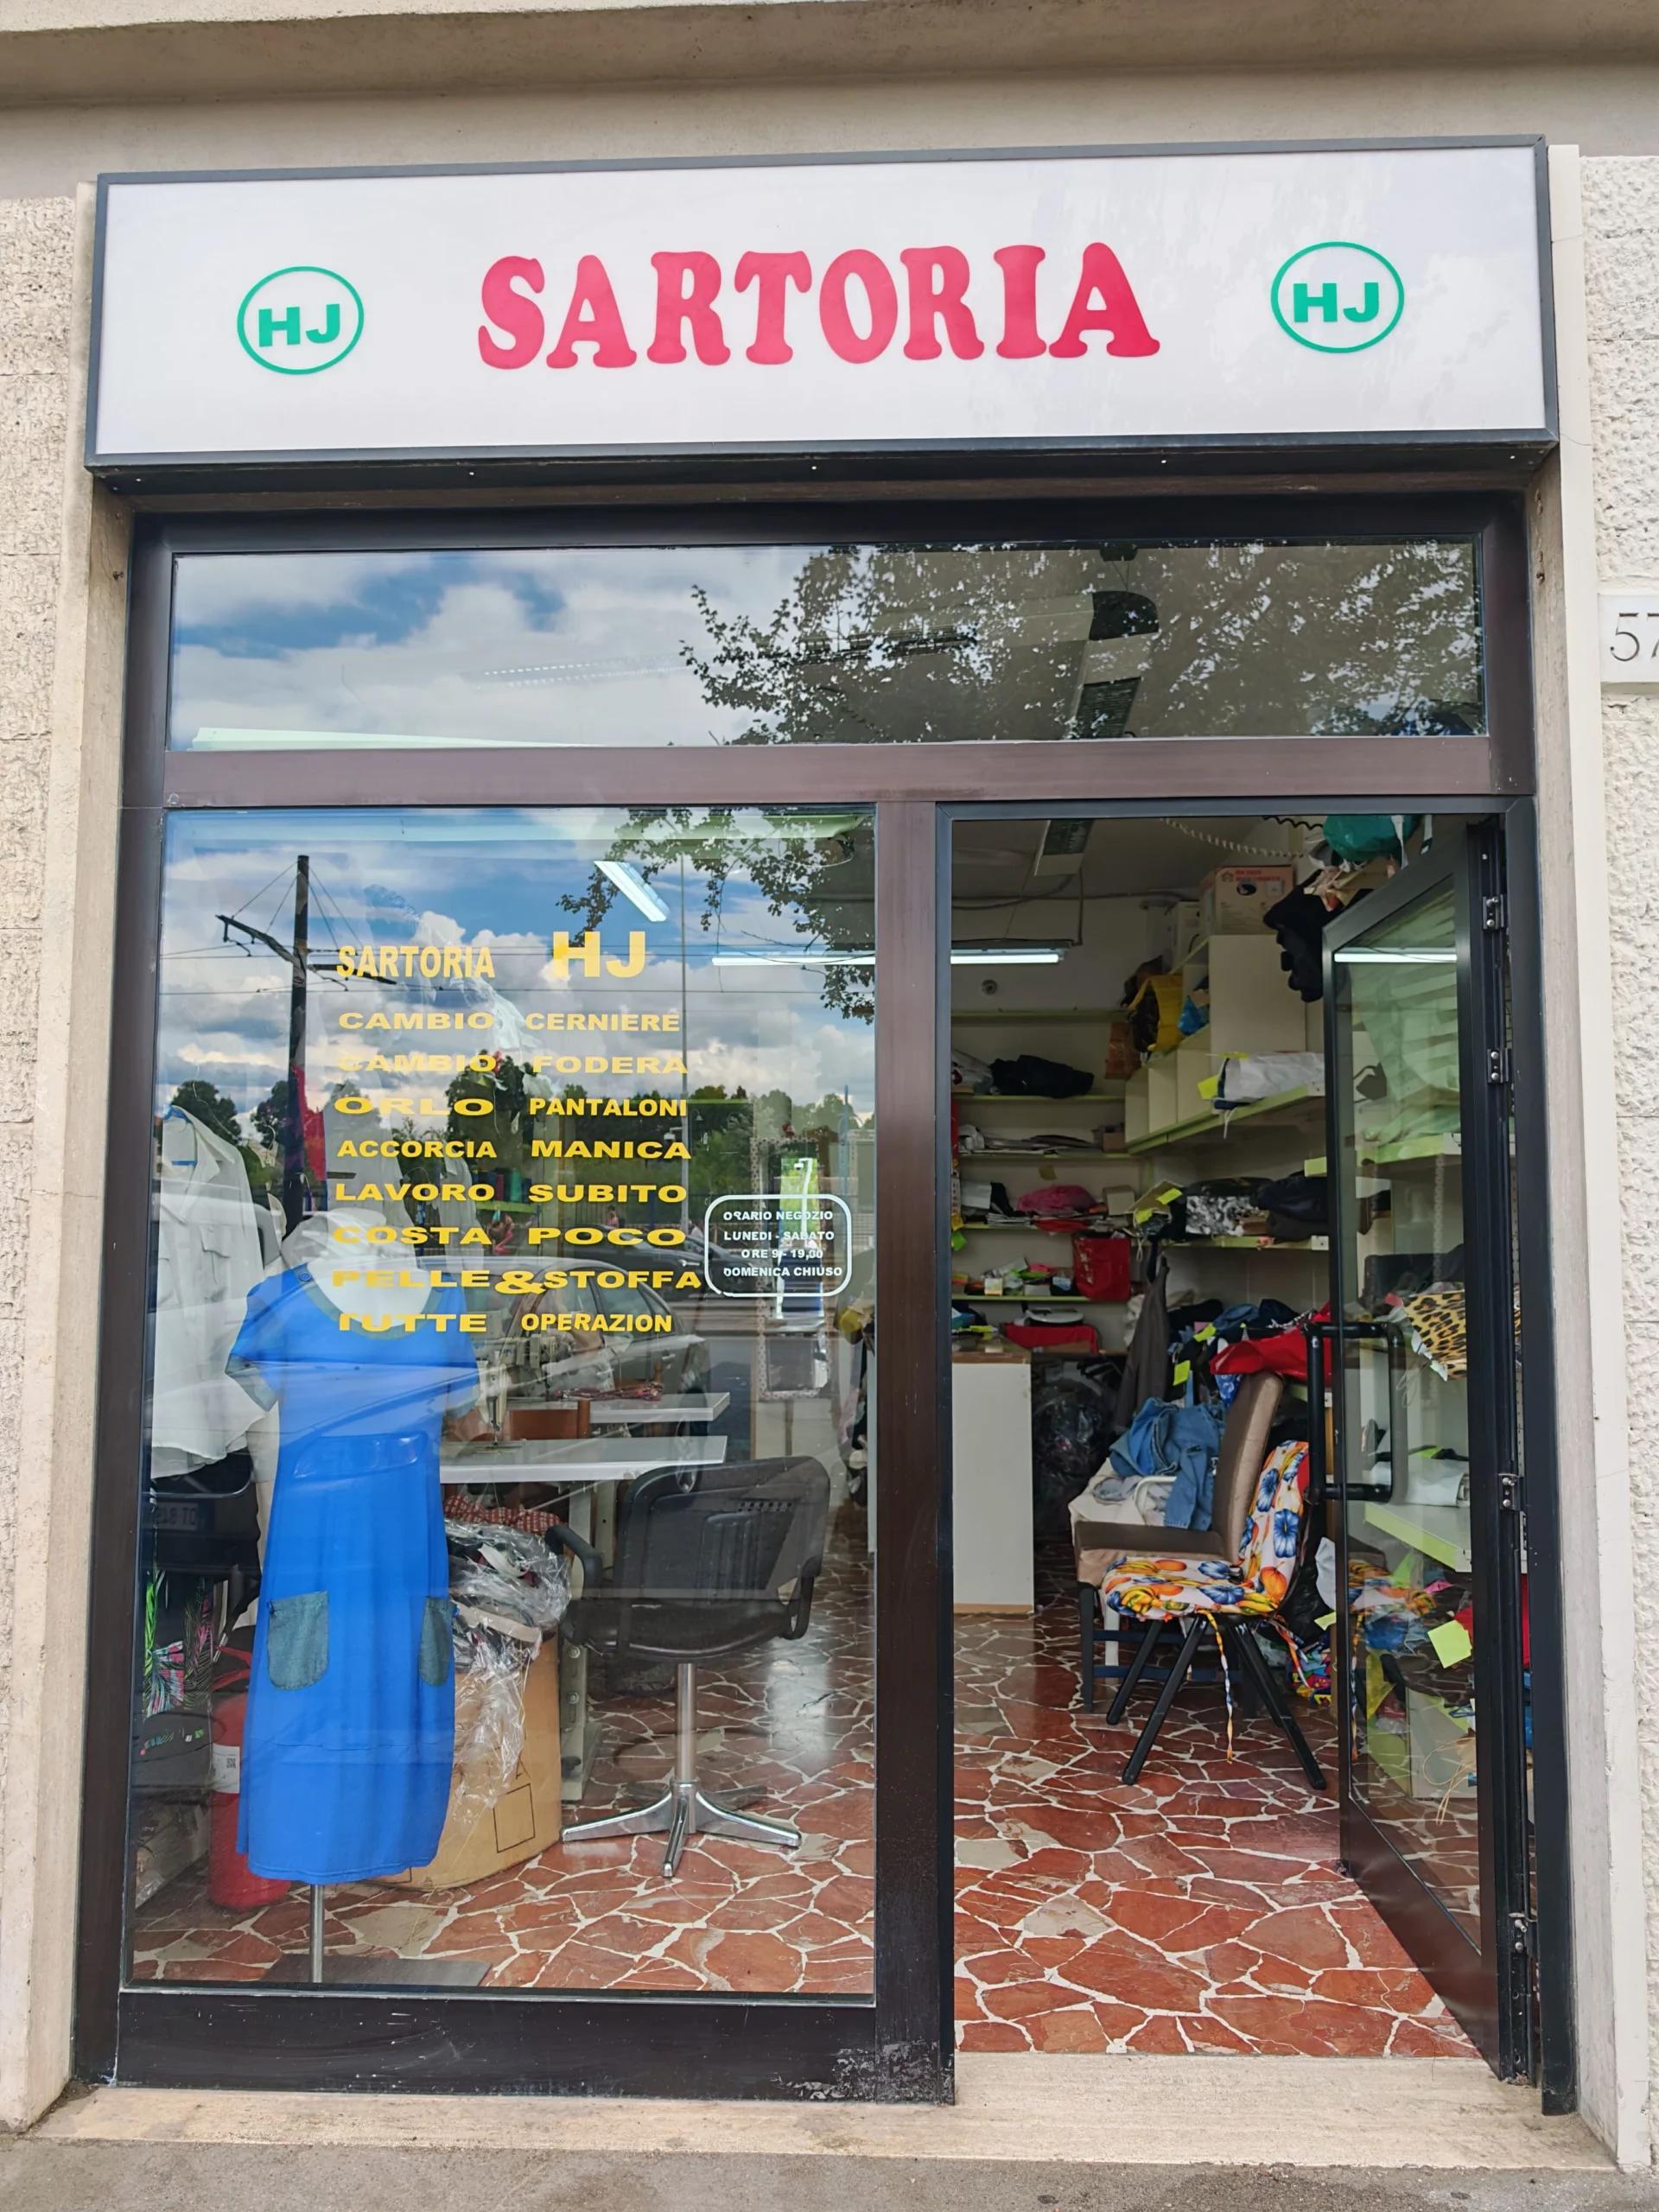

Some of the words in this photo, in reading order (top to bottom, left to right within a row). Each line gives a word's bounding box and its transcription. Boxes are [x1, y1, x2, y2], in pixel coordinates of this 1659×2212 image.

[478, 242, 1160, 370] SARTORIA
[1293, 281, 1381, 323] HJ
[258, 303, 341, 347] HJ
[336, 945, 495, 978] SARTORIA
[552, 931, 646, 978] HJ
[338, 1012, 493, 1030] CAMBIO
[525, 1013, 680, 1032] CERNIERE
[336, 1054, 497, 1072] CAMBIO
[532, 1056, 688, 1074] FODERA
[334, 1096, 494, 1116] ORLO
[530, 1097, 687, 1116] PANTALONI
[337, 1140, 498, 1159] ACCORCIA
[531, 1140, 691, 1160] MANICA
[335, 1183, 495, 1202] LAVORO
[529, 1184, 687, 1203] SUBITO
[723, 1211, 772, 1221] ORARIO
[776, 1211, 834, 1221] NEGOZIO
[333, 1226, 493, 1245] COSTA
[528, 1227, 685, 1246] POCO
[723, 1231, 772, 1241] LUNEDI
[783, 1231, 835, 1242] SABATO
[741, 1249, 770, 1259] ORE
[723, 1267, 791, 1277] DOMENICA
[793, 1267, 842, 1277] CHIUSO
[339, 1313, 487, 1332] TUTTE
[521, 1313, 673, 1332] OPERAZION
